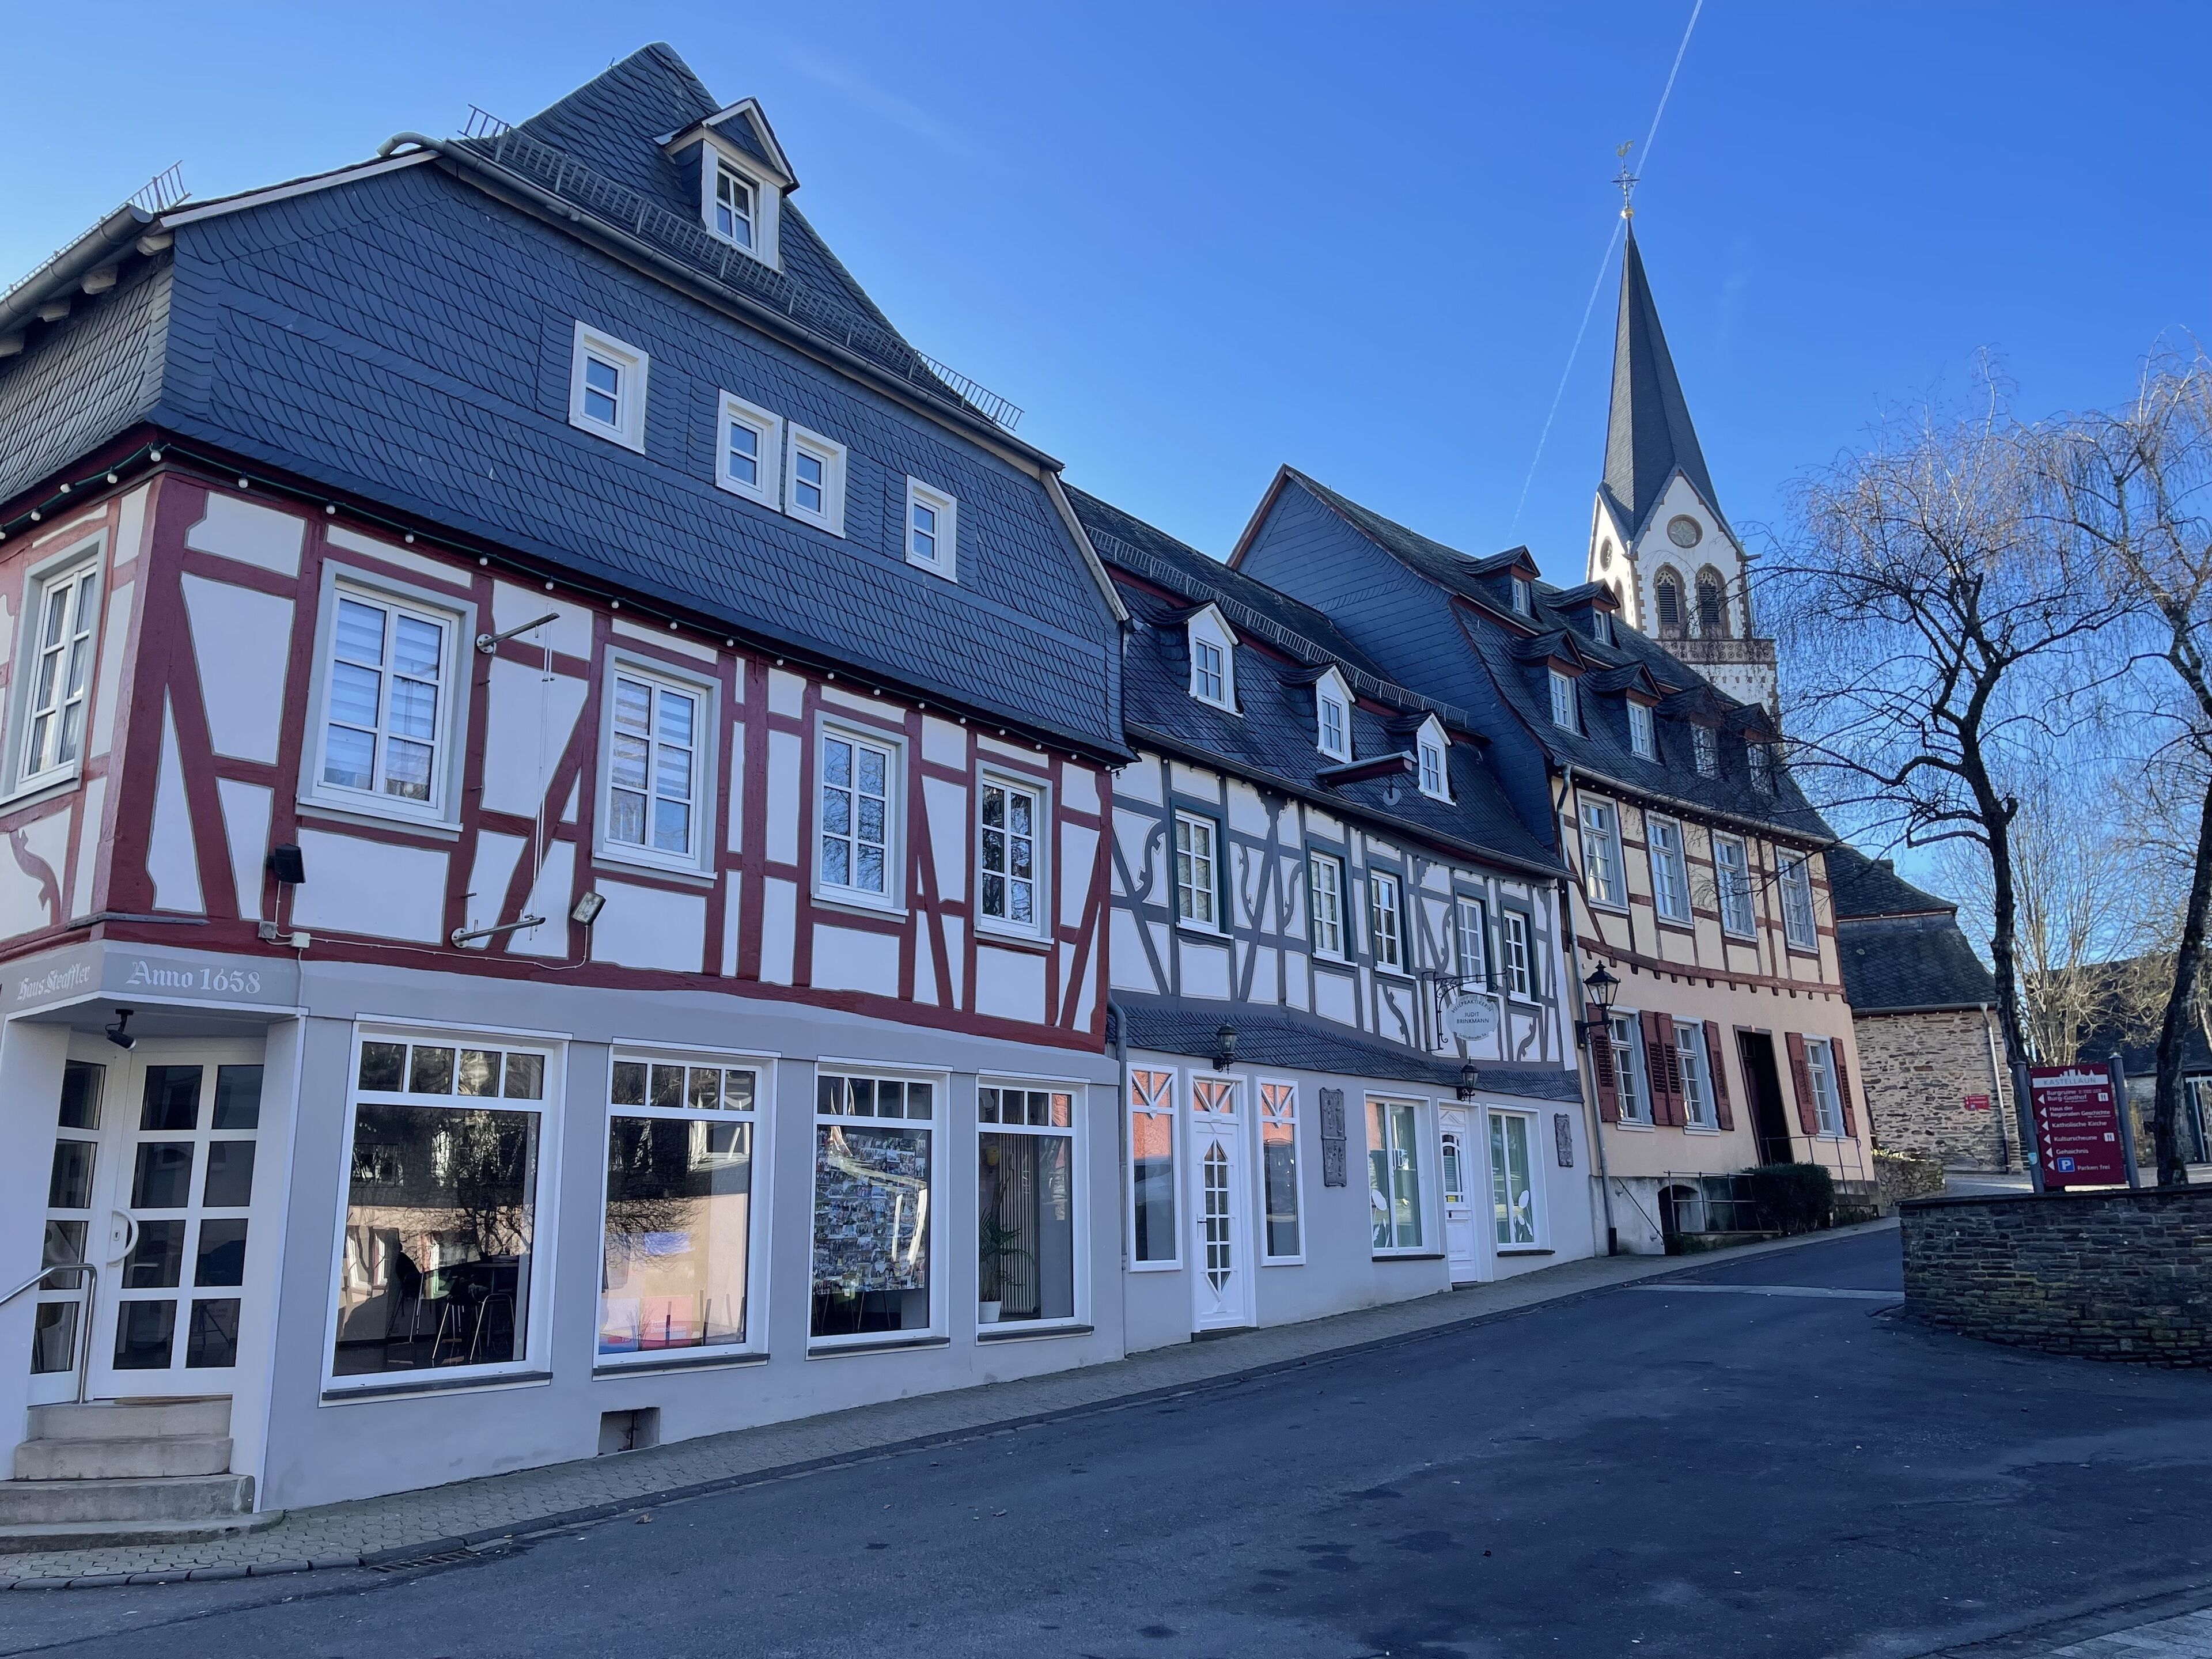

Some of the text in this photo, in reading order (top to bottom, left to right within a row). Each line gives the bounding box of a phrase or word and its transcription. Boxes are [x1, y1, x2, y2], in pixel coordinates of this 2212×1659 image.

[126, 960, 261, 994] Anno 1658
[1452, 999, 1493, 1013] HEILPRAKTIKERIN
[2043, 1077, 2096, 1086] KASTELLAUN
[2061, 1160, 2071, 1170] P
